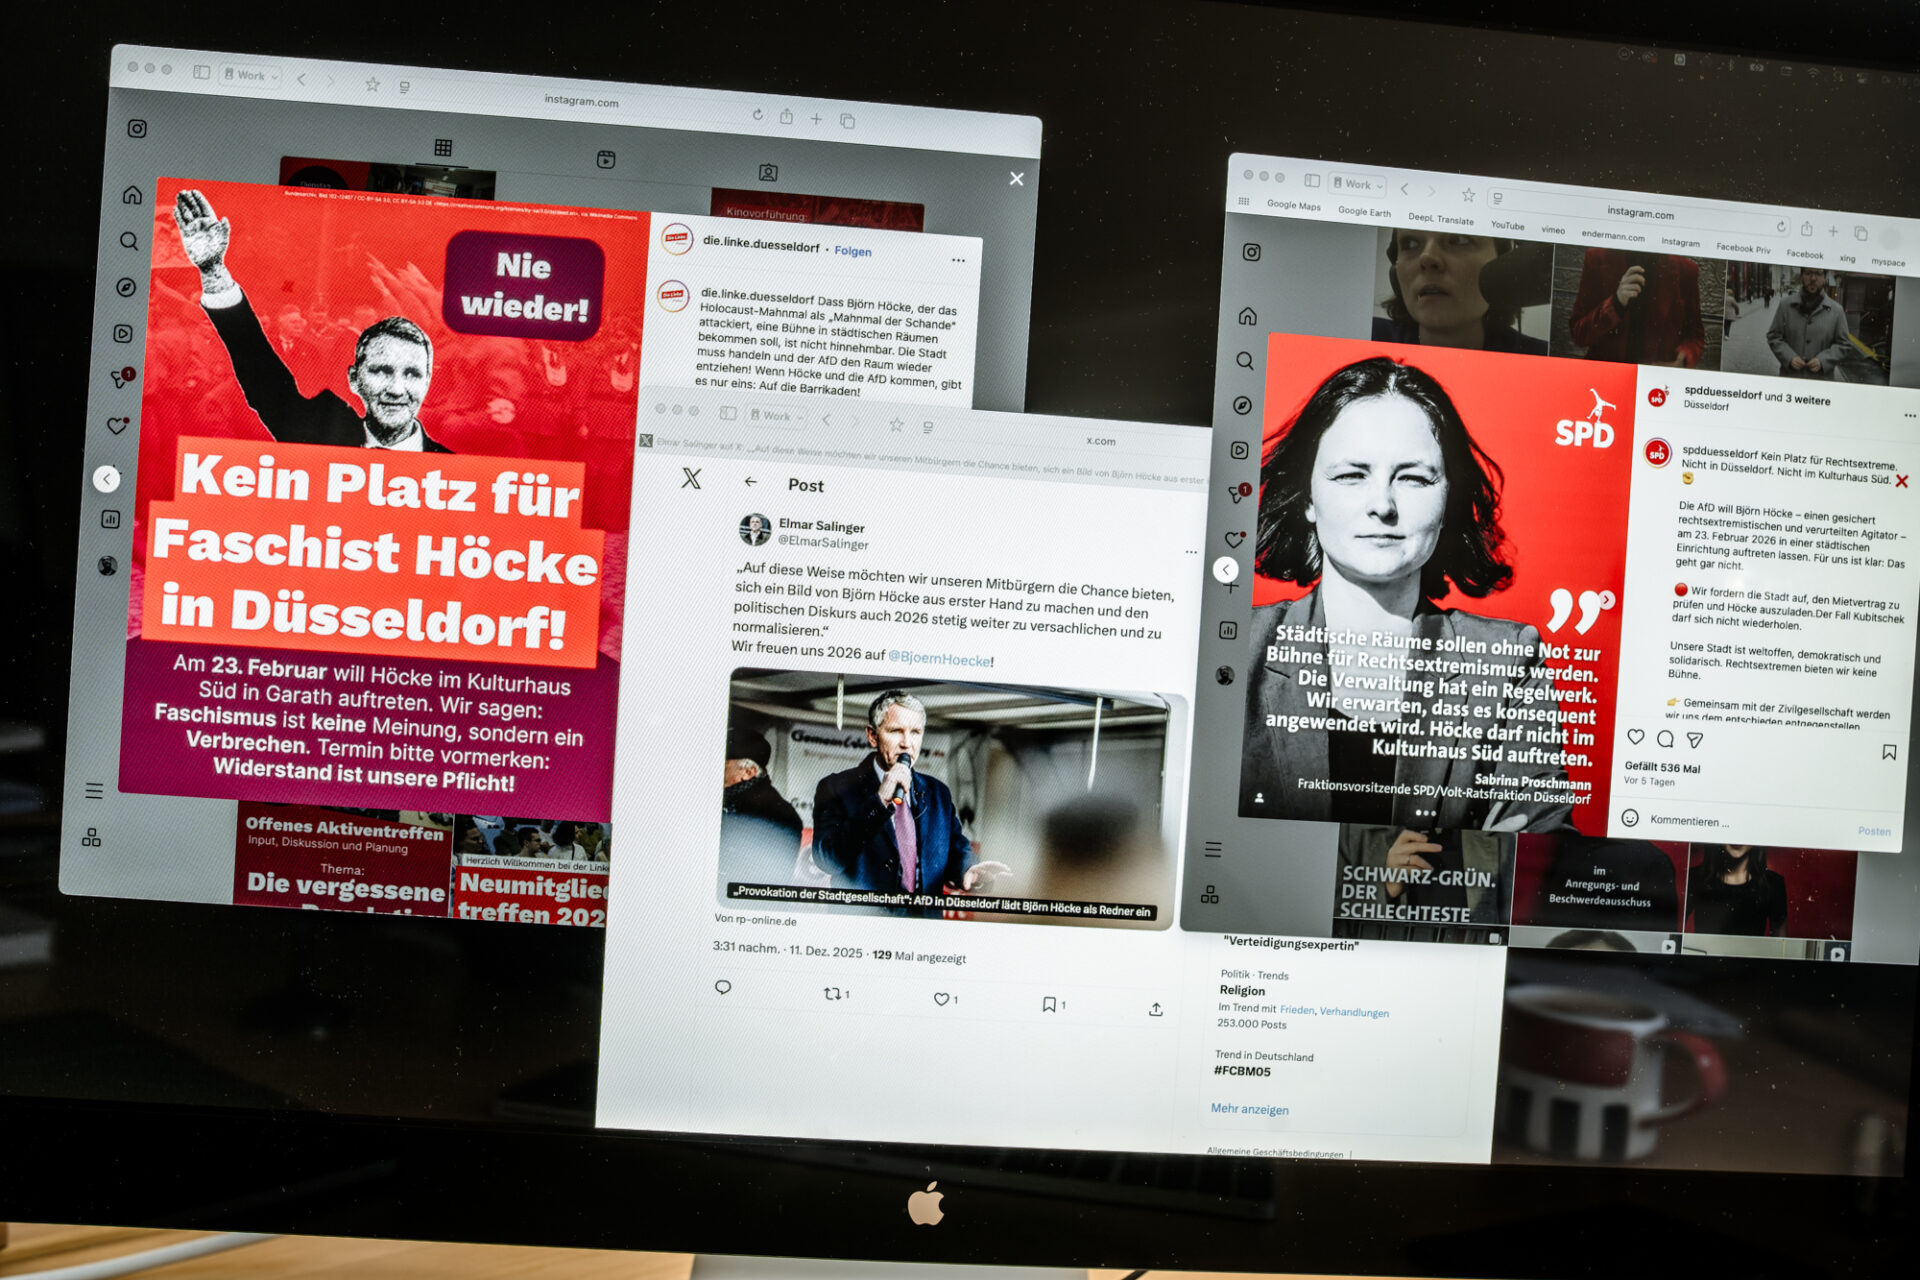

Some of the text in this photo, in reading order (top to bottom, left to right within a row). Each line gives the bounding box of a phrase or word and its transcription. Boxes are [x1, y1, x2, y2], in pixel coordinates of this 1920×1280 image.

[544, 92, 619, 107] instagram.com
[1266, 198, 1321, 211] Google Maps
[1338, 205, 1391, 217] Google Earth
[1607, 205, 1674, 220] instagram.com
[1491, 220, 1525, 231] YouTube
[1541, 226, 1565, 235] vimeo
[702, 234, 820, 253] die.linke.duesseldorf
[834, 245, 871, 257] Folgen
[1581, 230, 1645, 242] endermann.com
[1661, 237, 1700, 248] Instagram
[1716, 242, 1771, 254] Facebook Priv
[1786, 248, 1823, 259] Facebook
[496, 252, 551, 279] Nie
[1839, 255, 1856, 264] xing
[1871, 257, 1906, 267] myspace
[460, 290, 588, 323] wieder!
[1684, 385, 1831, 406] spdduesseldorf und 3 weitere
[1086, 437, 1116, 446] x.com
[1553, 417, 1616, 451] SPD
[181, 453, 580, 518] Kein Platz für
[788, 477, 824, 493] Post
[779, 517, 865, 535] Elmar Salinger
[153, 518, 598, 586] Faschist Höcke
[777, 534, 869, 552] @ElmarSalinger
[161, 581, 565, 650] in Düsseldorf!
[732, 622, 828, 637] normalisieren.“
[1276, 625, 1601, 661] Städtische Räume sollen ohne Not zur
[732, 640, 994, 668] Wir freuen uns 2026 auf @BjoernHoecke!
[1267, 646, 1598, 682] Bühne für Rechtsextremismus werden.
[172, 653, 571, 696] Am 23. Februar will Höcke im Kulturhaus
[1298, 670, 1597, 704] Die Verwaltung hat ein Regelwerk.
[198, 680, 542, 721] Süd in Garath auftreten. Wir sagen:
[1307, 692, 1596, 727] Wir erwarten, dass es konsequent
[154, 702, 583, 746] Faschismus ist keine Meinung, sondern ein
[1266, 714, 1594, 746] angewendet wird. Höcke darf nicht im
[186, 729, 549, 769] Verbrechen. Termin bitte vormerken:
[1372, 738, 1592, 767] Kulturhaus Süd auftreten.
[213, 756, 514, 792] Widerstand ist unsere Pflicht!
[1624, 760, 1700, 774] Gefällt 536 Mal
[1297, 777, 1592, 804] Fraktionsvorsitzende SPD/Volt-Ratsfraktion Düsseldorf
[1474, 772, 1591, 790] Sabrina Proschmann
[245, 816, 443, 840] Offenes Aktiventreffen
[320, 862, 364, 875] Thema:
[1342, 865, 1495, 887] SCHWARZ-GRÜN.
[247, 871, 445, 902] Die vergessene
[1341, 883, 1377, 900] DER
[1564, 878, 1640, 892] Anregungs- und
[733, 885, 797, 898] „Provokation
[799, 889, 817, 899] der
[913, 895, 932, 905] AfD
[935, 896, 943, 905] in
[946, 897, 999, 908] Düsseldorf
[1001, 900, 1019, 909] lädt
[1022, 901, 1048, 912] Björn
[1050, 903, 1080, 913] Höcke
[1083, 904, 1096, 913] als
[1099, 905, 1134, 915] Redner
[1135, 907, 1150, 916] ein
[1548, 893, 1651, 907] Beschwerdeausschuss
[458, 901, 550, 922] treffen
[556, 907, 606, 928] 202
[714, 912, 797, 926] Von rp-online.de
[1341, 900, 1470, 923] SCHLECHTESTE
[1223, 933, 1362, 951] "Verteidigungsexpertin"
[712, 940, 966, 966] 3:31 nachm. 11. Dez. 2025 129 Mal angezeigt
[1219, 984, 1265, 997] Religion
[1213, 1065, 1271, 1077] #FCBM05
[1210, 1102, 1289, 1117] Mehr anzeigen
